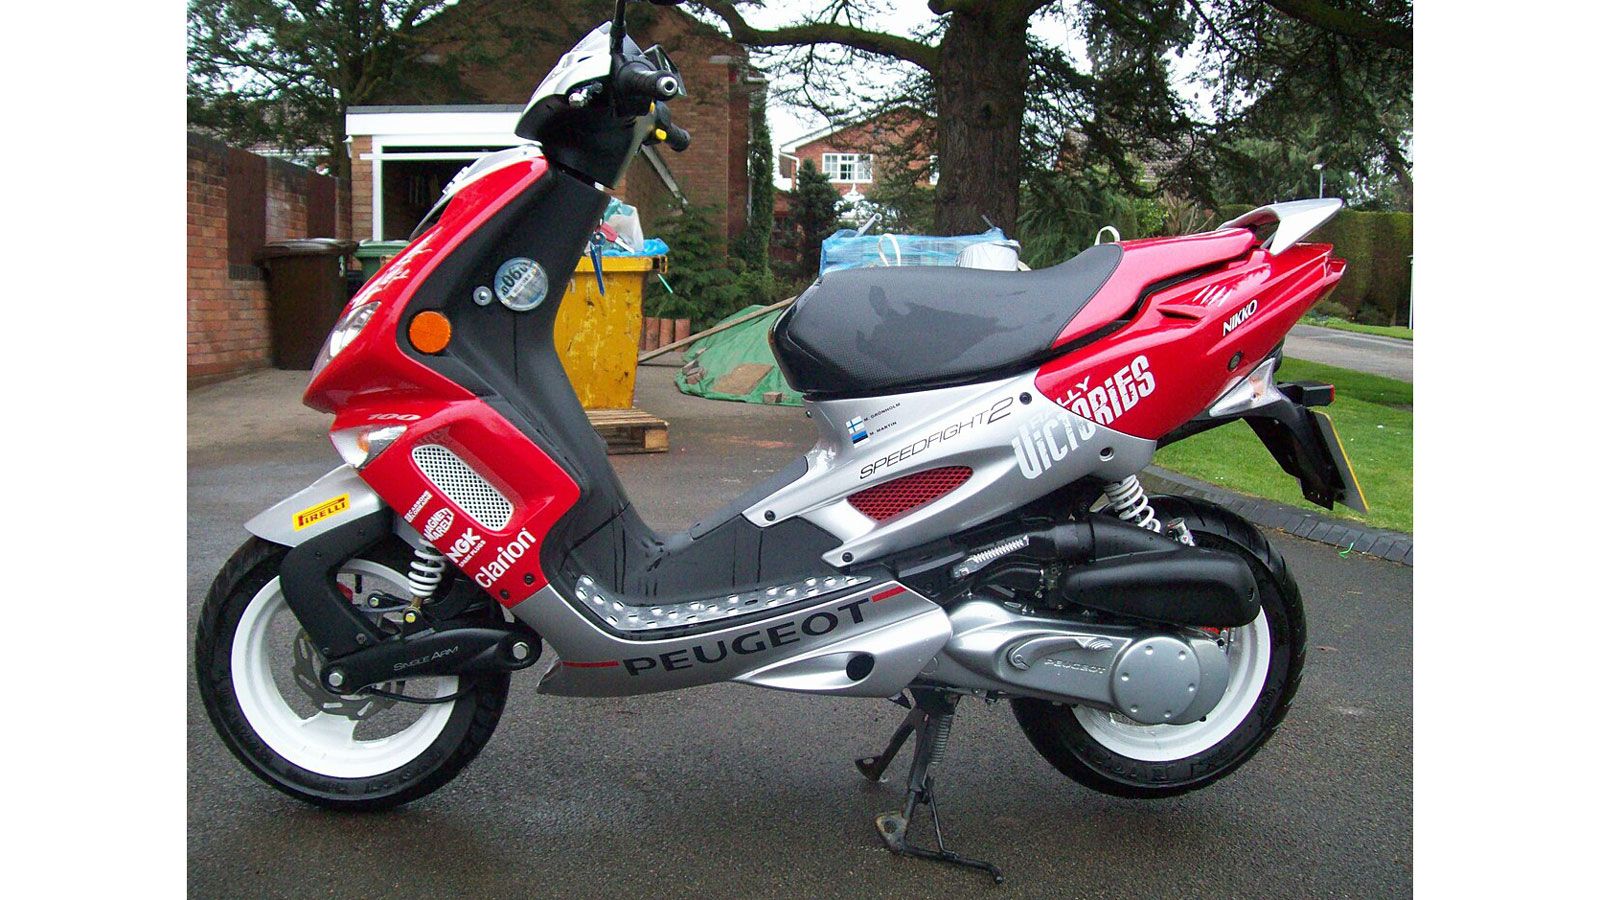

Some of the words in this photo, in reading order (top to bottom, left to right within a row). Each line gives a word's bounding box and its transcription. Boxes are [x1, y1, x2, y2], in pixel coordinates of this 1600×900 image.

[1223, 299, 1258, 337] NIKKO
[368, 413, 422, 421] 100
[298, 497, 346, 527] PIRELLI
[445, 527, 481, 564] NGK
[623, 597, 870, 676] PEUGEOT
[1044, 658, 1107, 675] PEUGEOT
